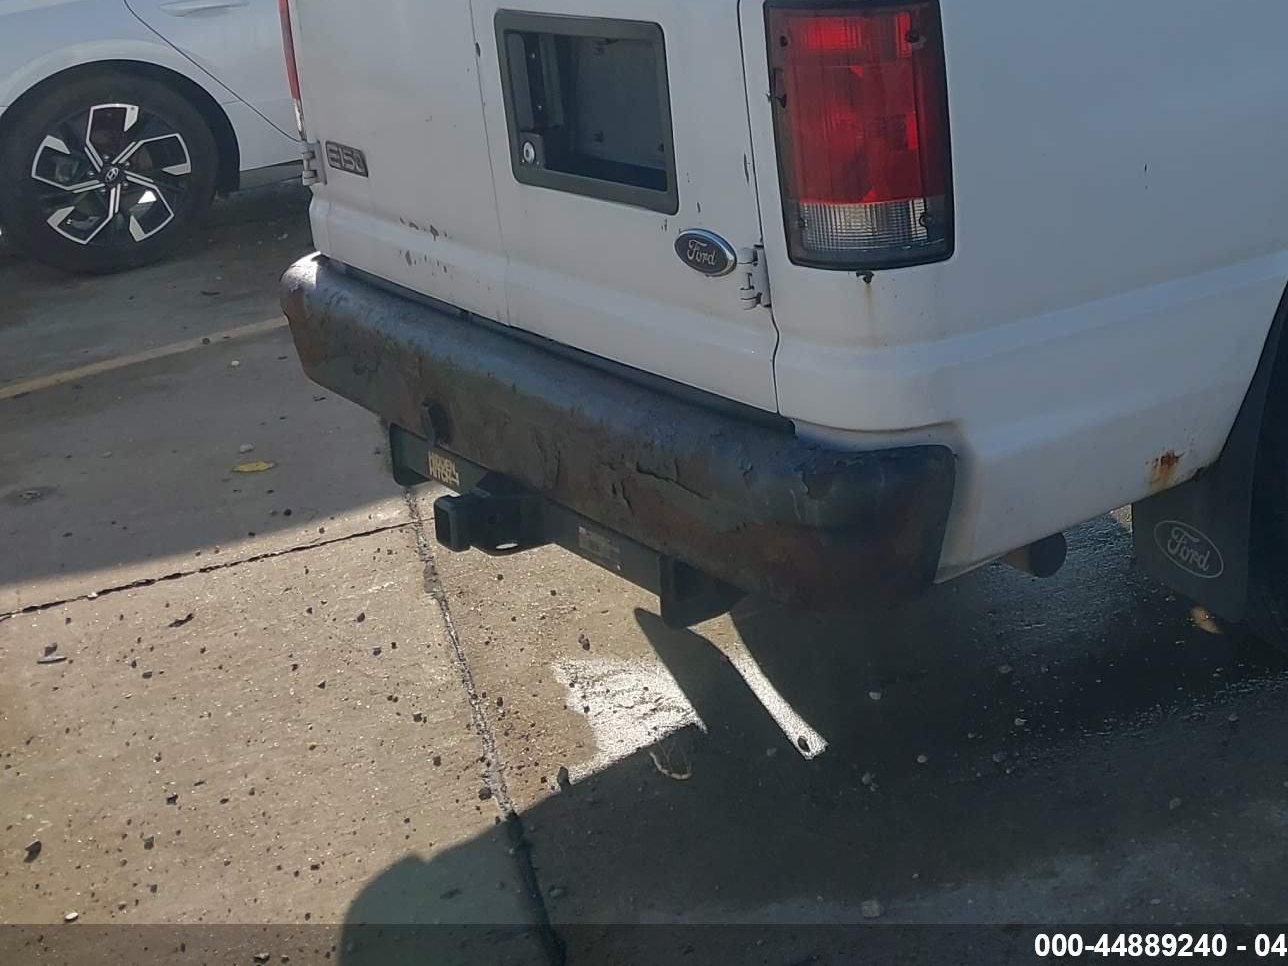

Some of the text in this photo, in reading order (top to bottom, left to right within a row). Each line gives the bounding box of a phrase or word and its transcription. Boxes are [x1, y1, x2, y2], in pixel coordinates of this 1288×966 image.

[327, 143, 366, 174] E150
[686, 239, 717, 266] Ford
[1167, 526, 1210, 571] Ford
